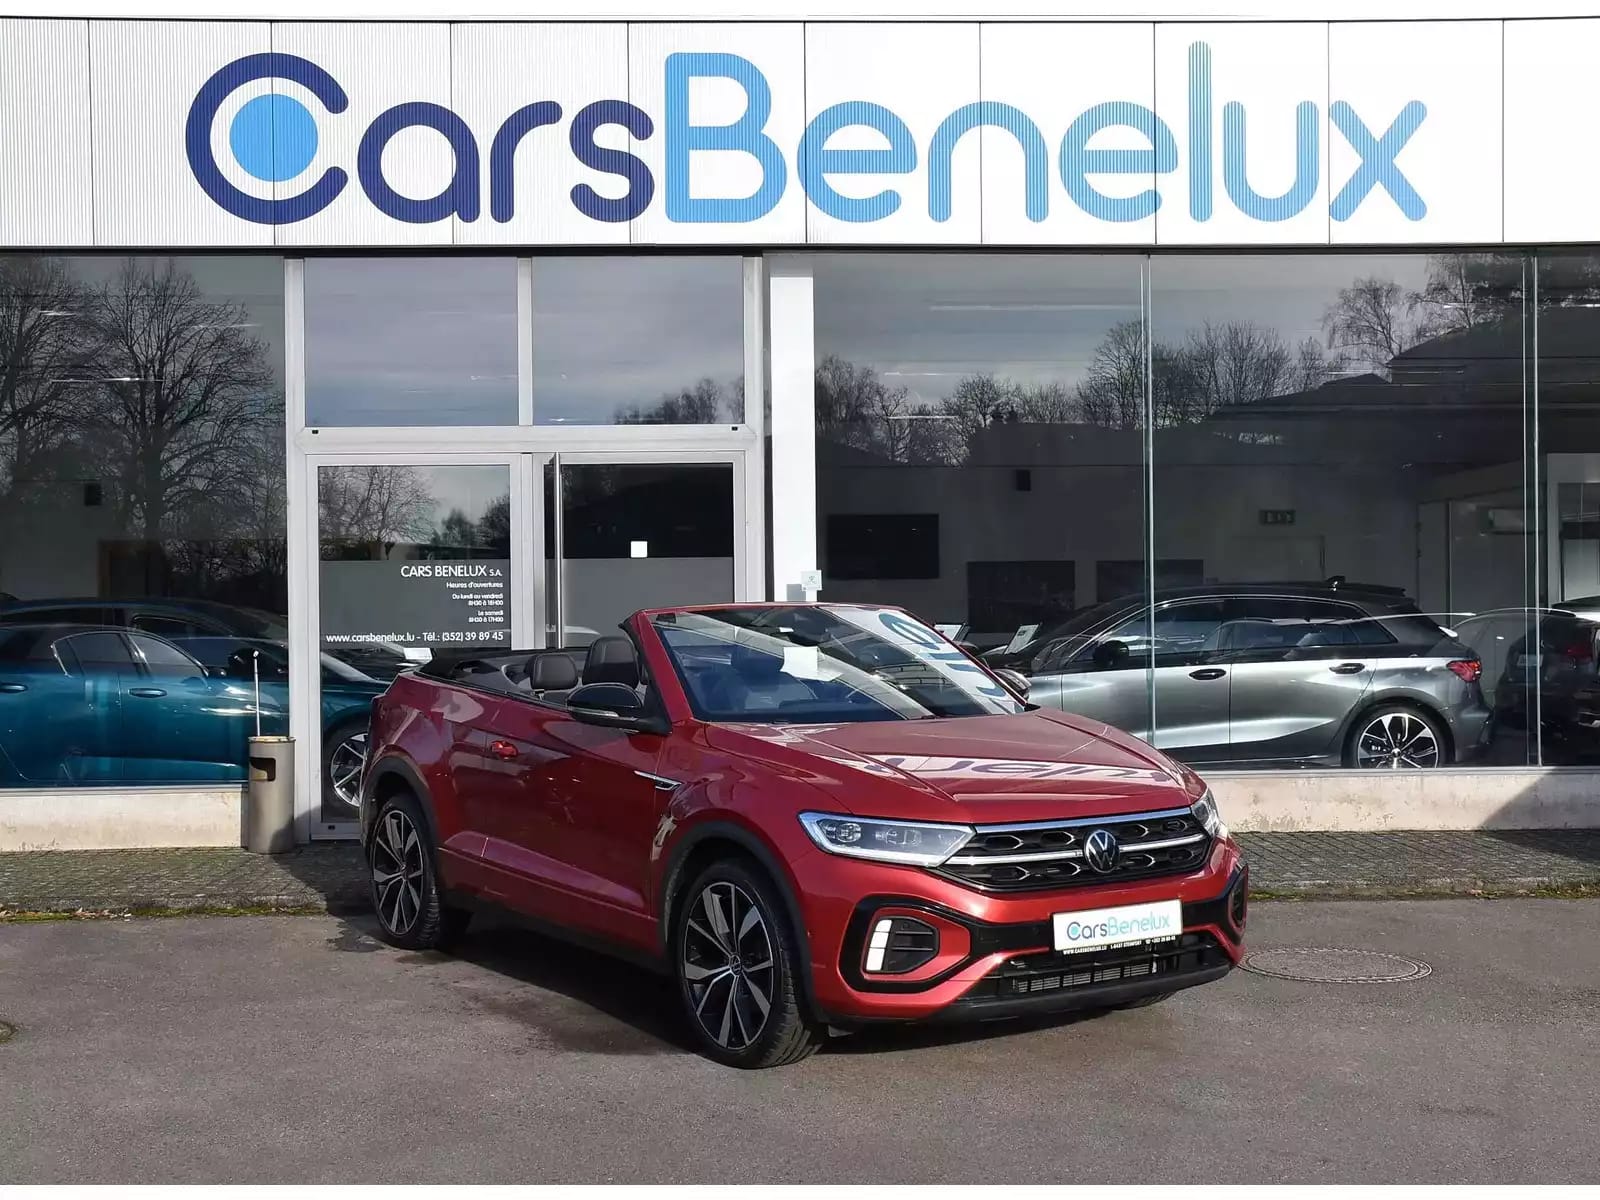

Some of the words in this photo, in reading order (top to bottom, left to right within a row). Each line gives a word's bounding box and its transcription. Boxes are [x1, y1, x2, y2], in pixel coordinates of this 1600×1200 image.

[185, 40, 1428, 224] CarsBenelux
[400, 565, 432, 577] CARS
[435, 565, 487, 577] BENELUX
[489, 568, 503, 577] S.A.
[468, 580, 503, 588] d'ouvertures
[326, 632, 415, 643] www.carsbenelux.lu
[442, 631, 463, 642] (352)
[465, 631, 477, 641] 39
[478, 631, 490, 641] 89
[491, 631, 503, 641] 45
[1066, 911, 1171, 941] CarsBenelux
